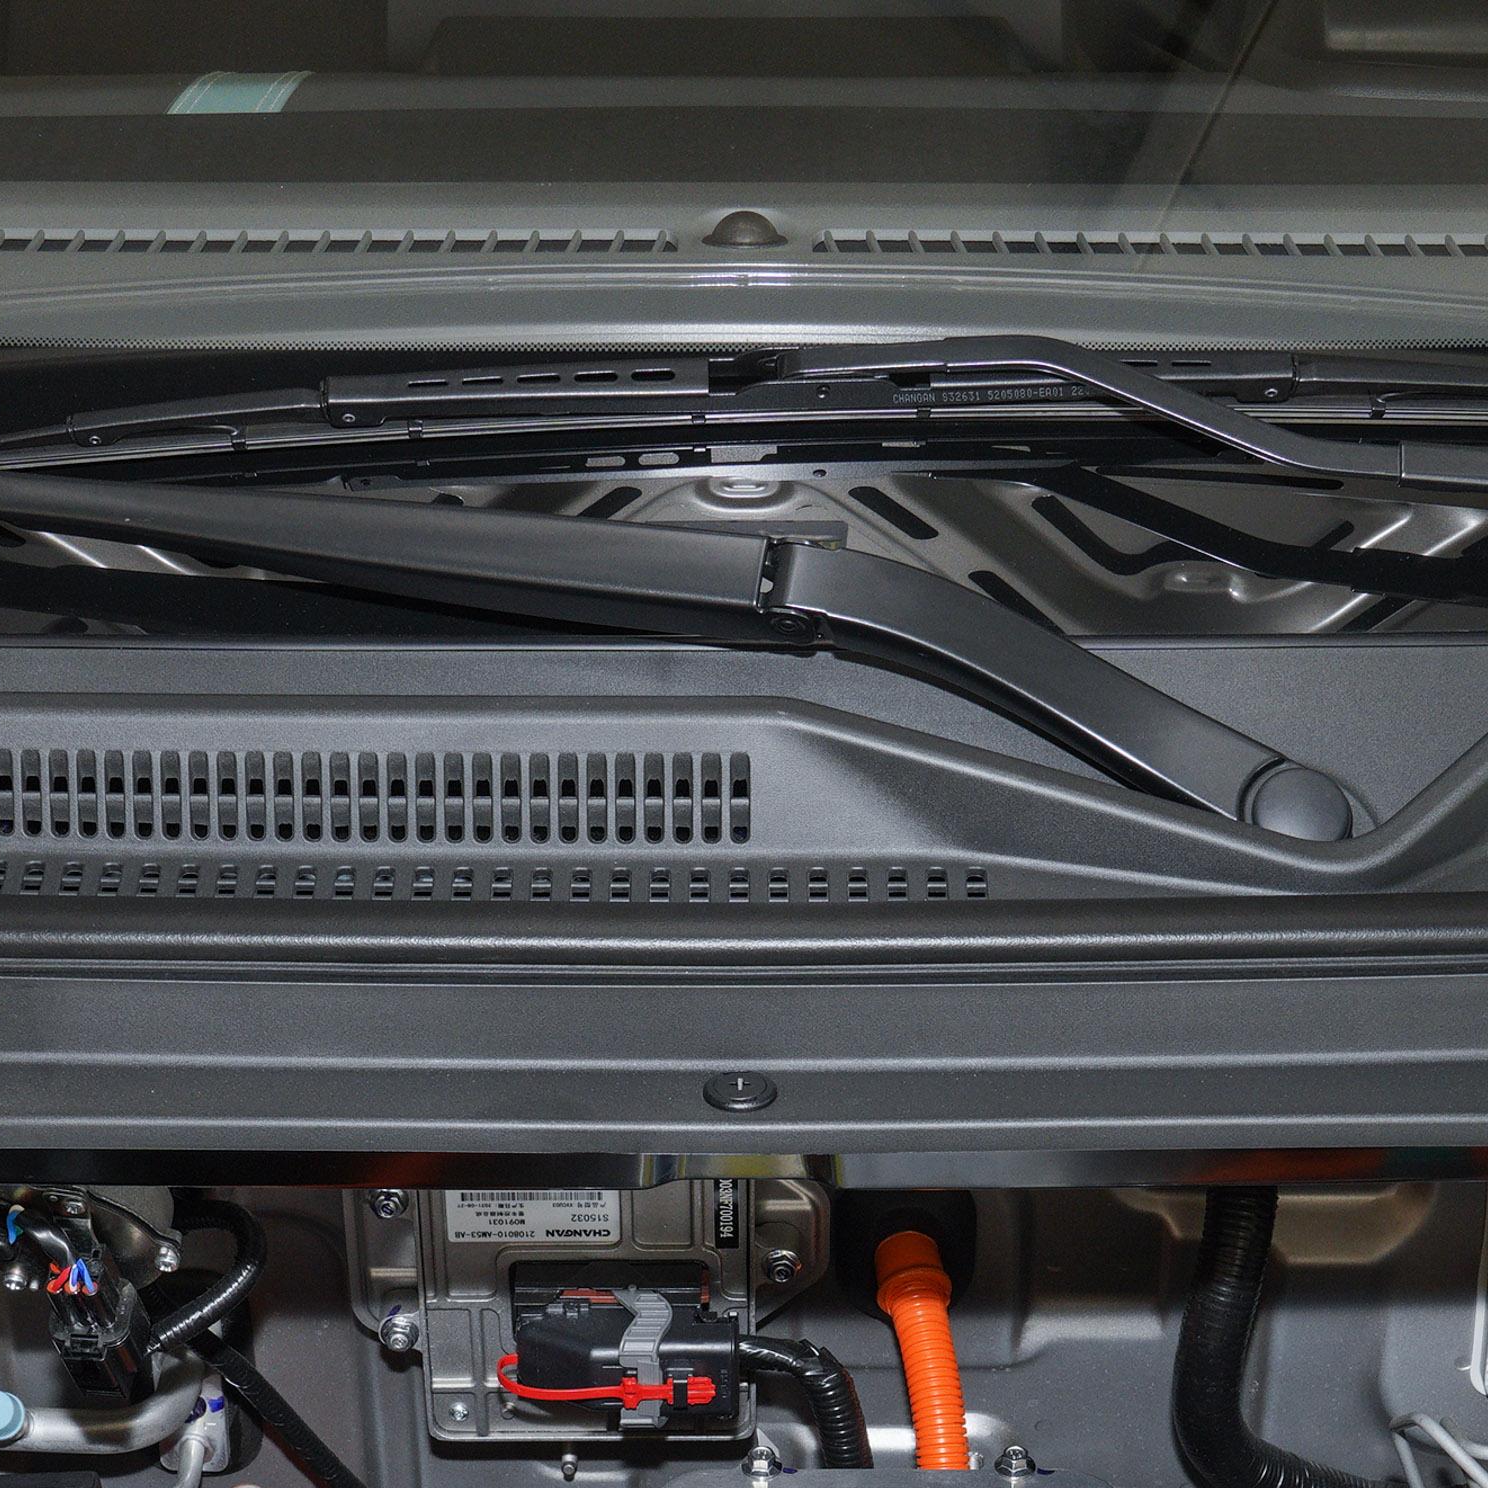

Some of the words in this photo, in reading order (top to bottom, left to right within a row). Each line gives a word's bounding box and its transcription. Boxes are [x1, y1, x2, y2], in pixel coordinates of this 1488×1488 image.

[893, 393, 935, 404] CHANGAN
[571, 1214, 608, 1222] S15032
[546, 1229, 610, 1237] CHANGAN
